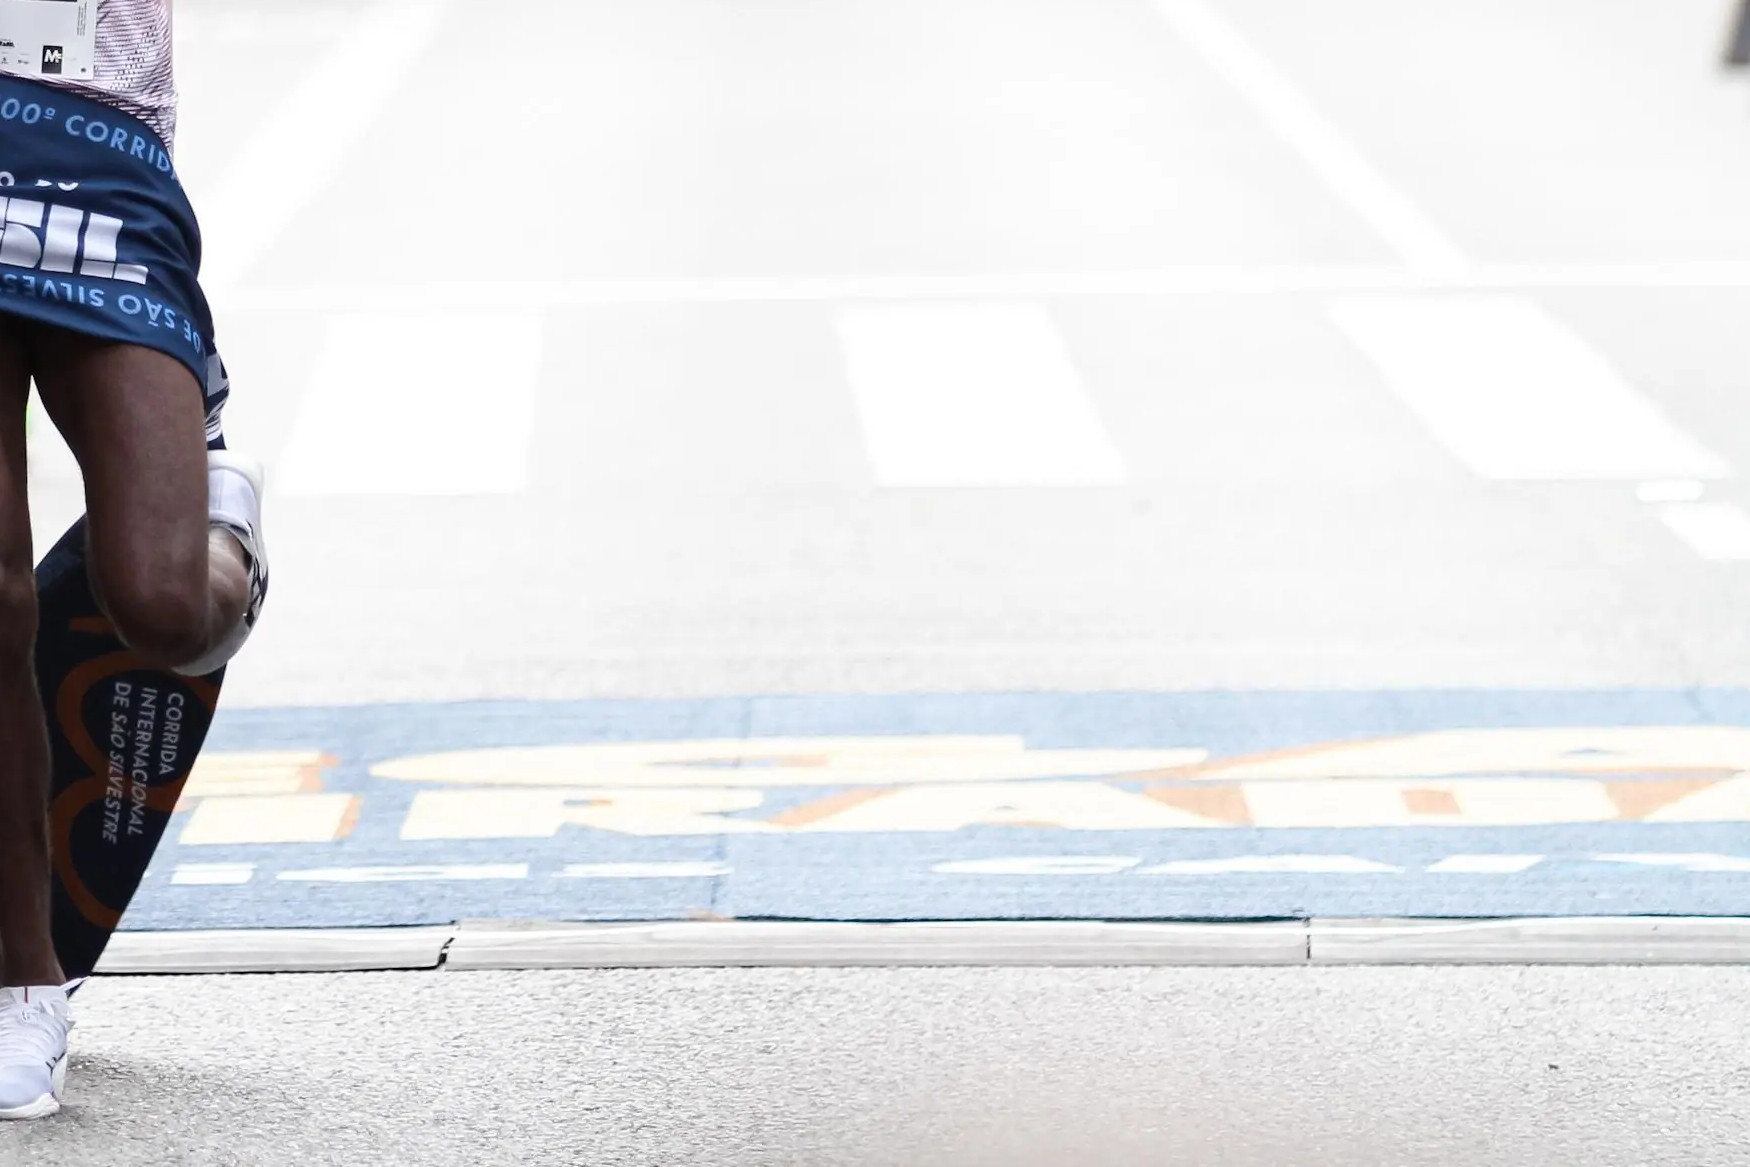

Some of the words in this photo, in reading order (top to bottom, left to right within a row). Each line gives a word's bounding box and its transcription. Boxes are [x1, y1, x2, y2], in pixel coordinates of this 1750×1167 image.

[117, 293, 177, 330] SÃO
[183, 318, 201, 354] DE
[113, 681, 132, 708] DE
[110, 711, 132, 749] SÃO
[158, 692, 185, 776] CORRIDA
[127, 686, 158, 836] INTERNACIONAL
[102, 750, 125, 845] SILVESTRE
